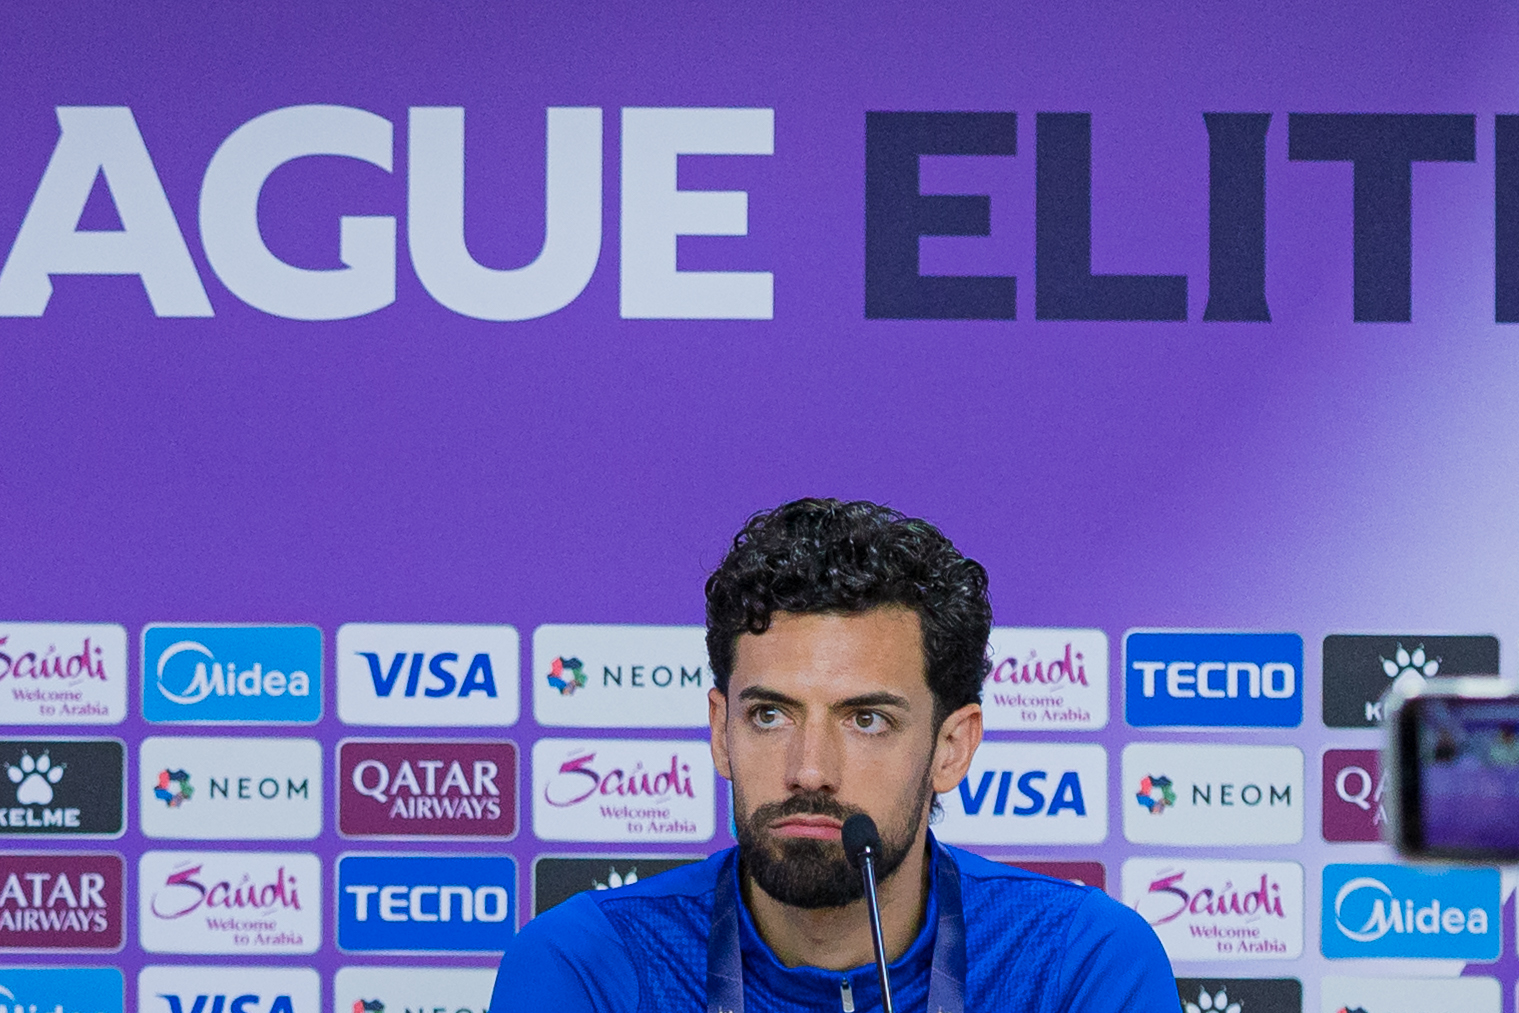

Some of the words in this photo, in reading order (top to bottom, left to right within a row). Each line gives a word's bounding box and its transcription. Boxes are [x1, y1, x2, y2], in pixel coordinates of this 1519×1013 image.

[864, 110, 1519, 324] ELIT
[354, 651, 499, 699] VISA
[602, 664, 703, 688] NEOM
[984, 642, 1090, 688] audi
[174, 659, 310, 705] Midea
[1132, 660, 1296, 699] TECNO
[11, 688, 83, 702] Welcome
[993, 693, 1064, 707] Welcome
[39, 702, 56, 716] to
[60, 702, 109, 717] Arabia
[1021, 708, 1037, 722] to
[1041, 708, 1091, 722] Arabia
[209, 777, 309, 801] NEOM
[353, 760, 500, 803] QATAR
[957, 770, 1088, 817] VISA
[1192, 784, 1292, 807] NEOM
[388, 797, 501, 821] AIRWAYS
[600, 805, 670, 820] Welcome
[627, 819, 644, 834] to
[648, 820, 697, 834] Arabia
[346, 884, 508, 923] TECNO
[206, 917, 277, 932] Welcome
[1189, 925, 1260, 939] Welcome
[1353, 898, 1489, 942] Midea
[233, 931, 250, 946] to
[254, 932, 304, 946] Arabia
[1217, 939, 1233, 953] to
[1237, 941, 1287, 954] Arabia
